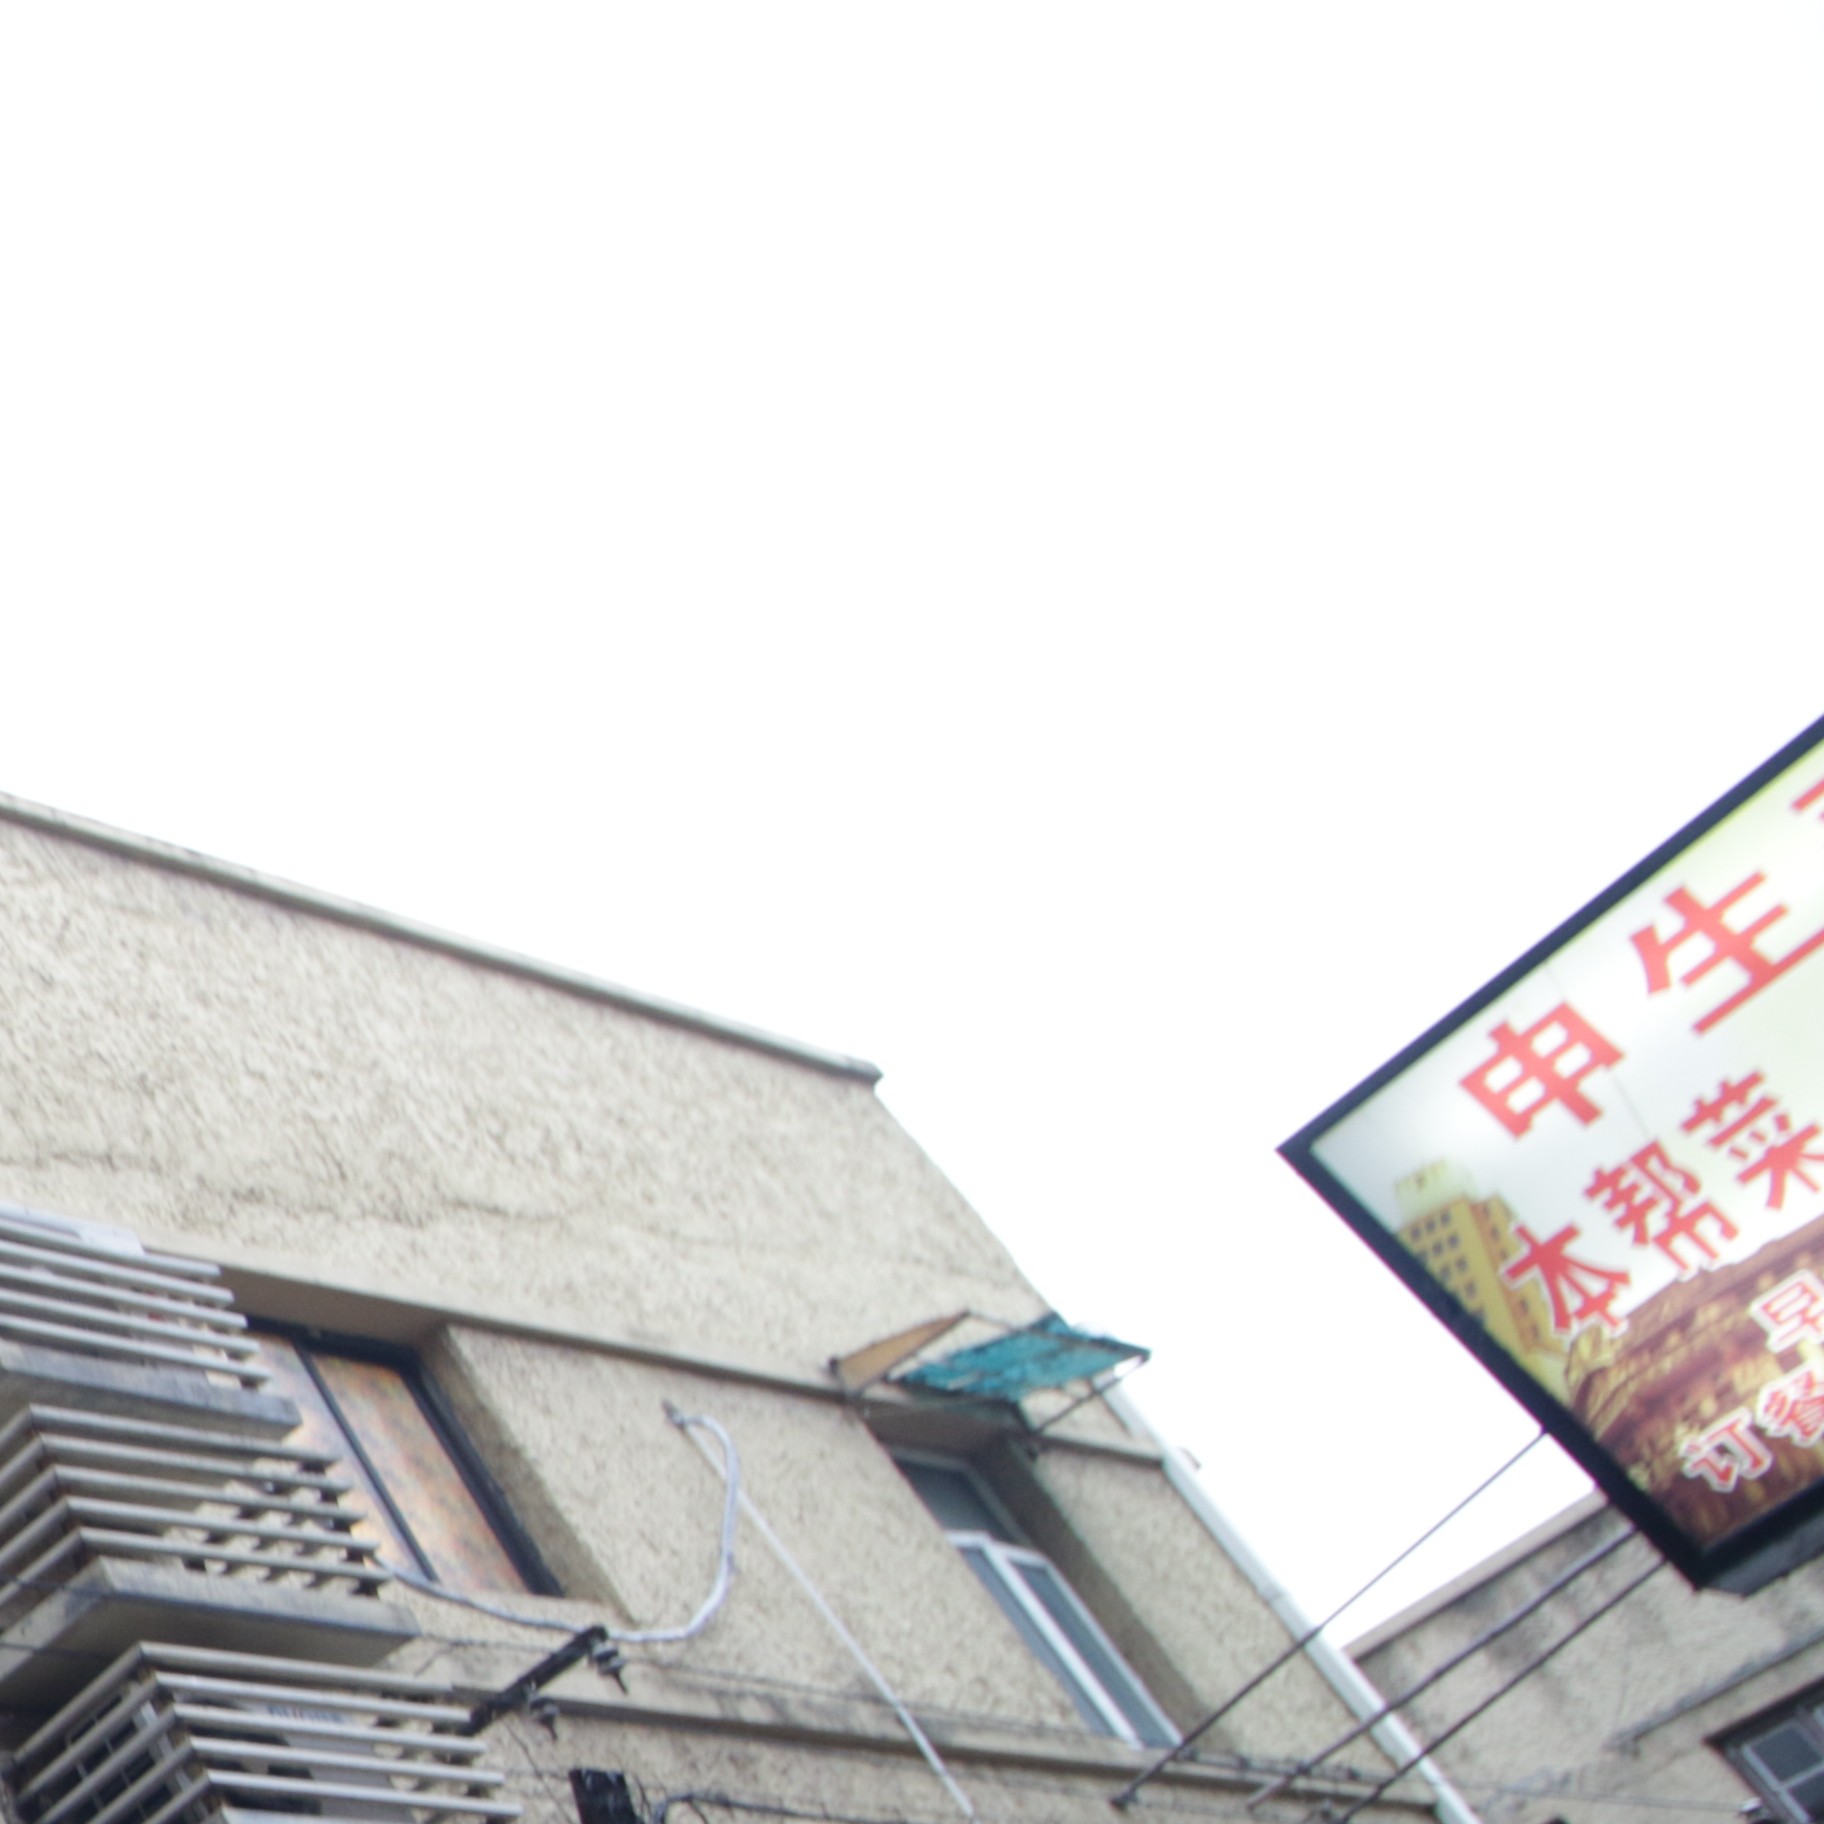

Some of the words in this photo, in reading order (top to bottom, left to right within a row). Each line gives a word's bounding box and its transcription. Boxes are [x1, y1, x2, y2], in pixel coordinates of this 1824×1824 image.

[1458, 775, 1824, 1143] 申生
[1502, 1070, 1824, 1336] 本帮菜
